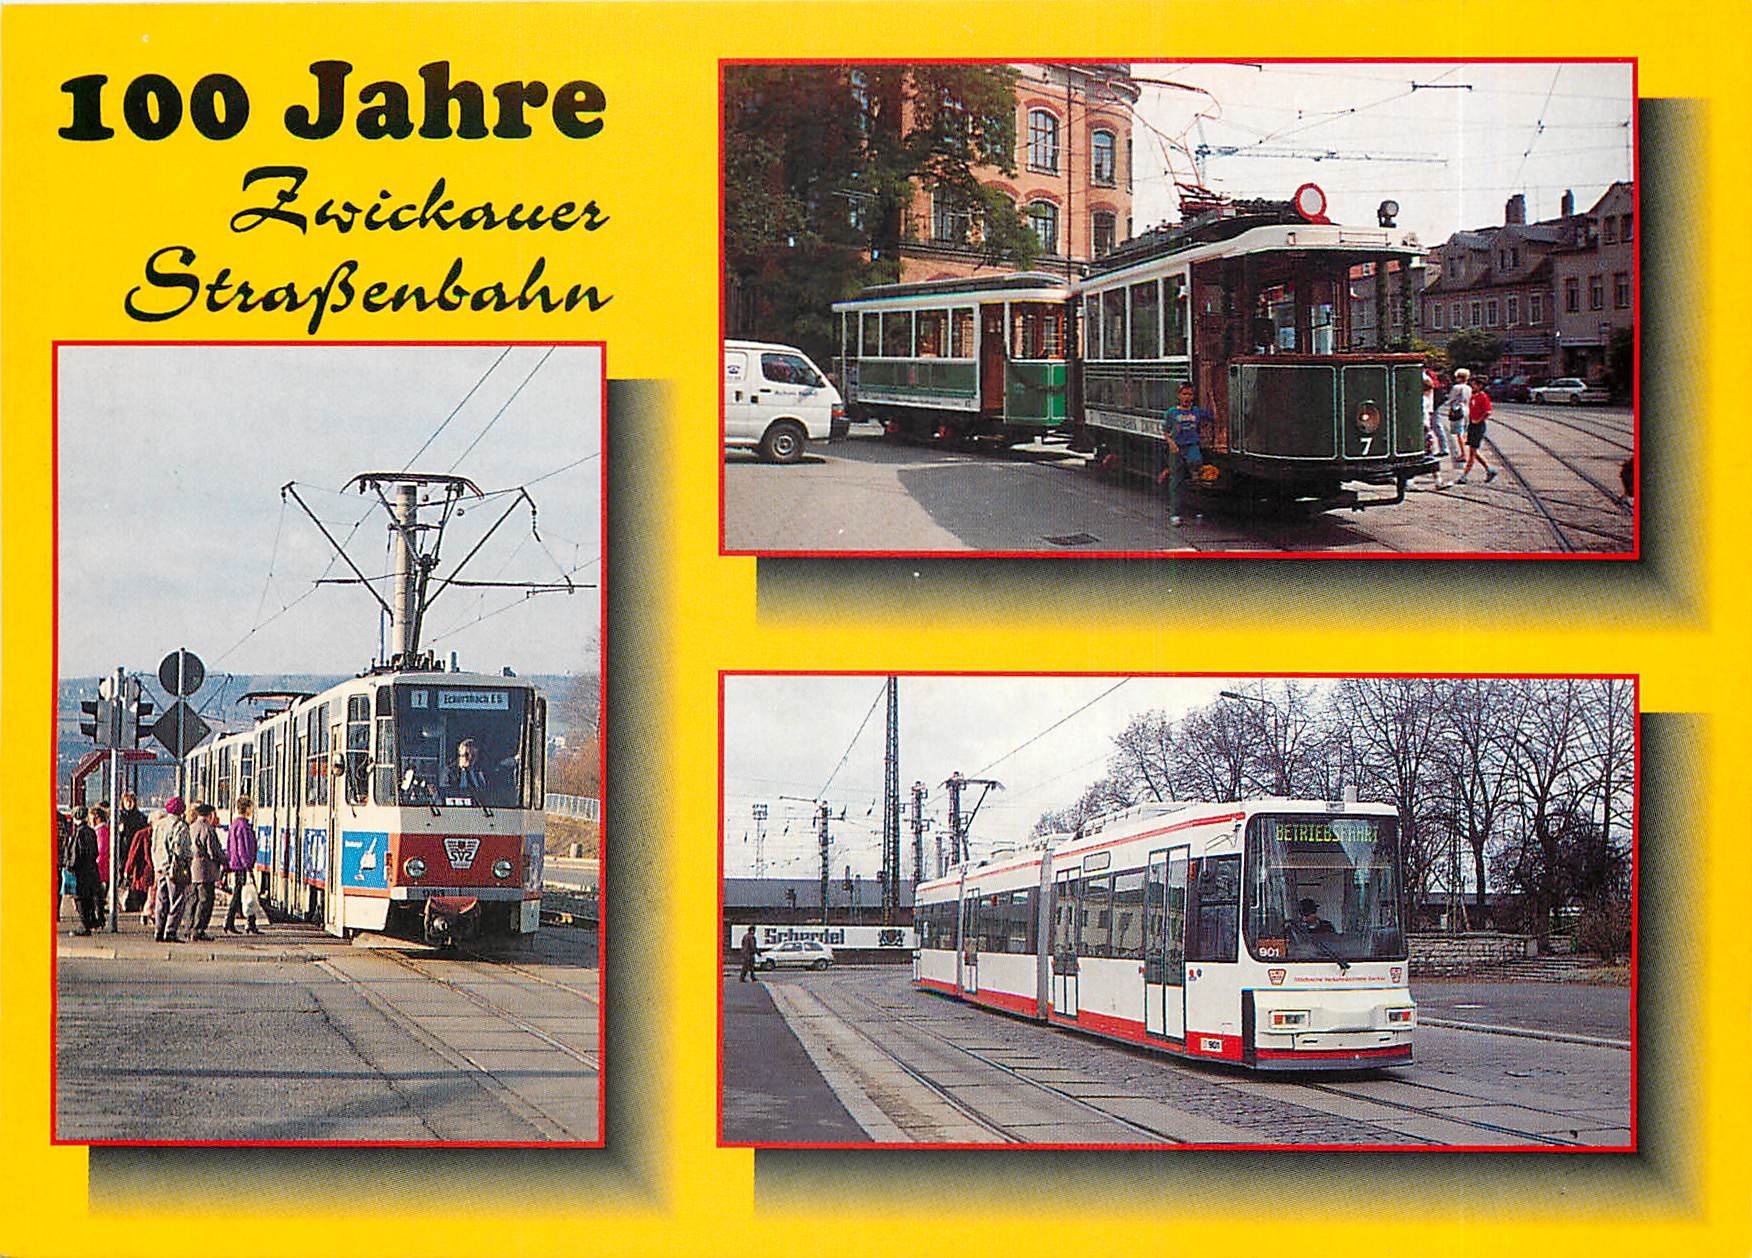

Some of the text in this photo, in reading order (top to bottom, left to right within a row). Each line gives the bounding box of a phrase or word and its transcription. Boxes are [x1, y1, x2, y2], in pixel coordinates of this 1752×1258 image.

[1360, 437, 1373, 456] 7
[1276, 823, 1380, 842] BETRIEBSFAHRT
[764, 928, 846, 945] Scherdel
[1258, 947, 1280, 958] 901
